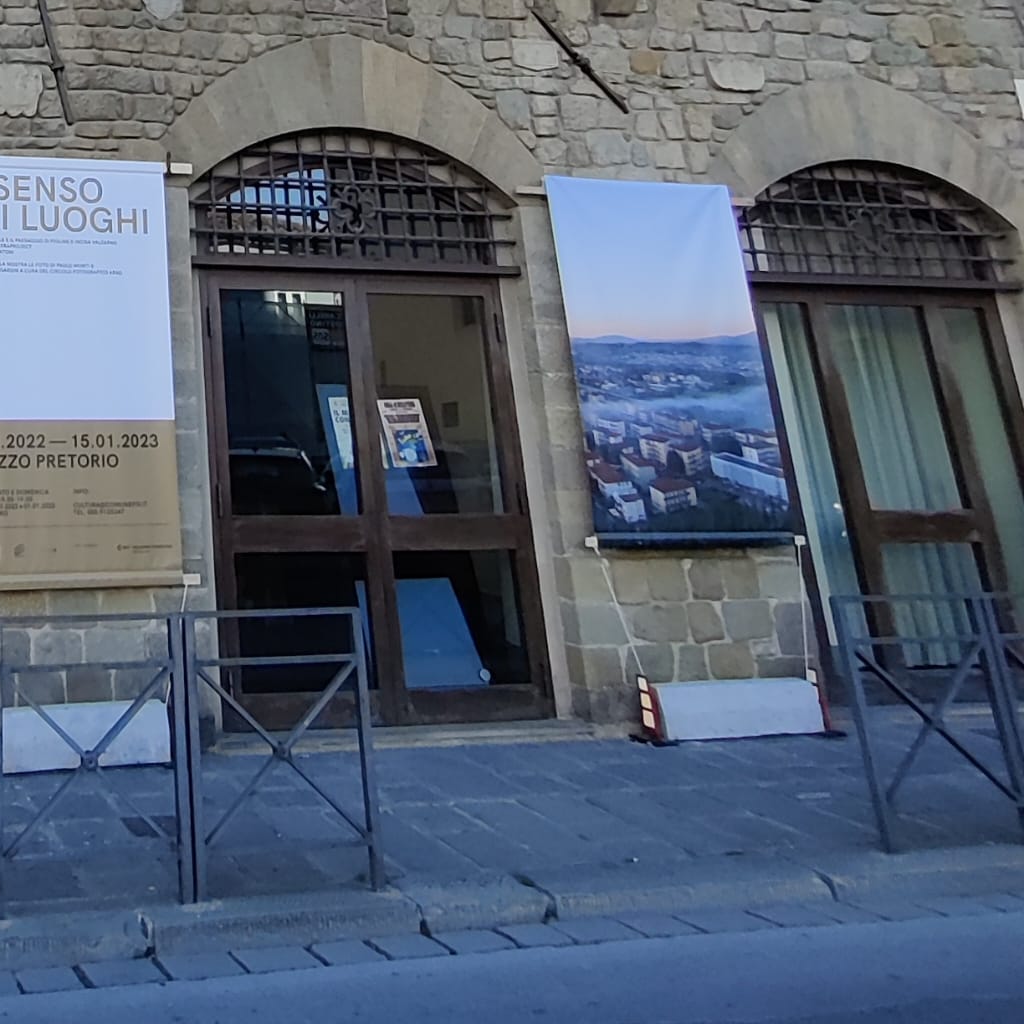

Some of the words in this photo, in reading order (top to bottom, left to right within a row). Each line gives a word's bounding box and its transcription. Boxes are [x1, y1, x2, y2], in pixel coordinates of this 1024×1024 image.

[22, 205, 149, 235] LUOGHI
[71, 433, 159, 448] 15.01.2023
[36, 453, 119, 468] PRETORIO
